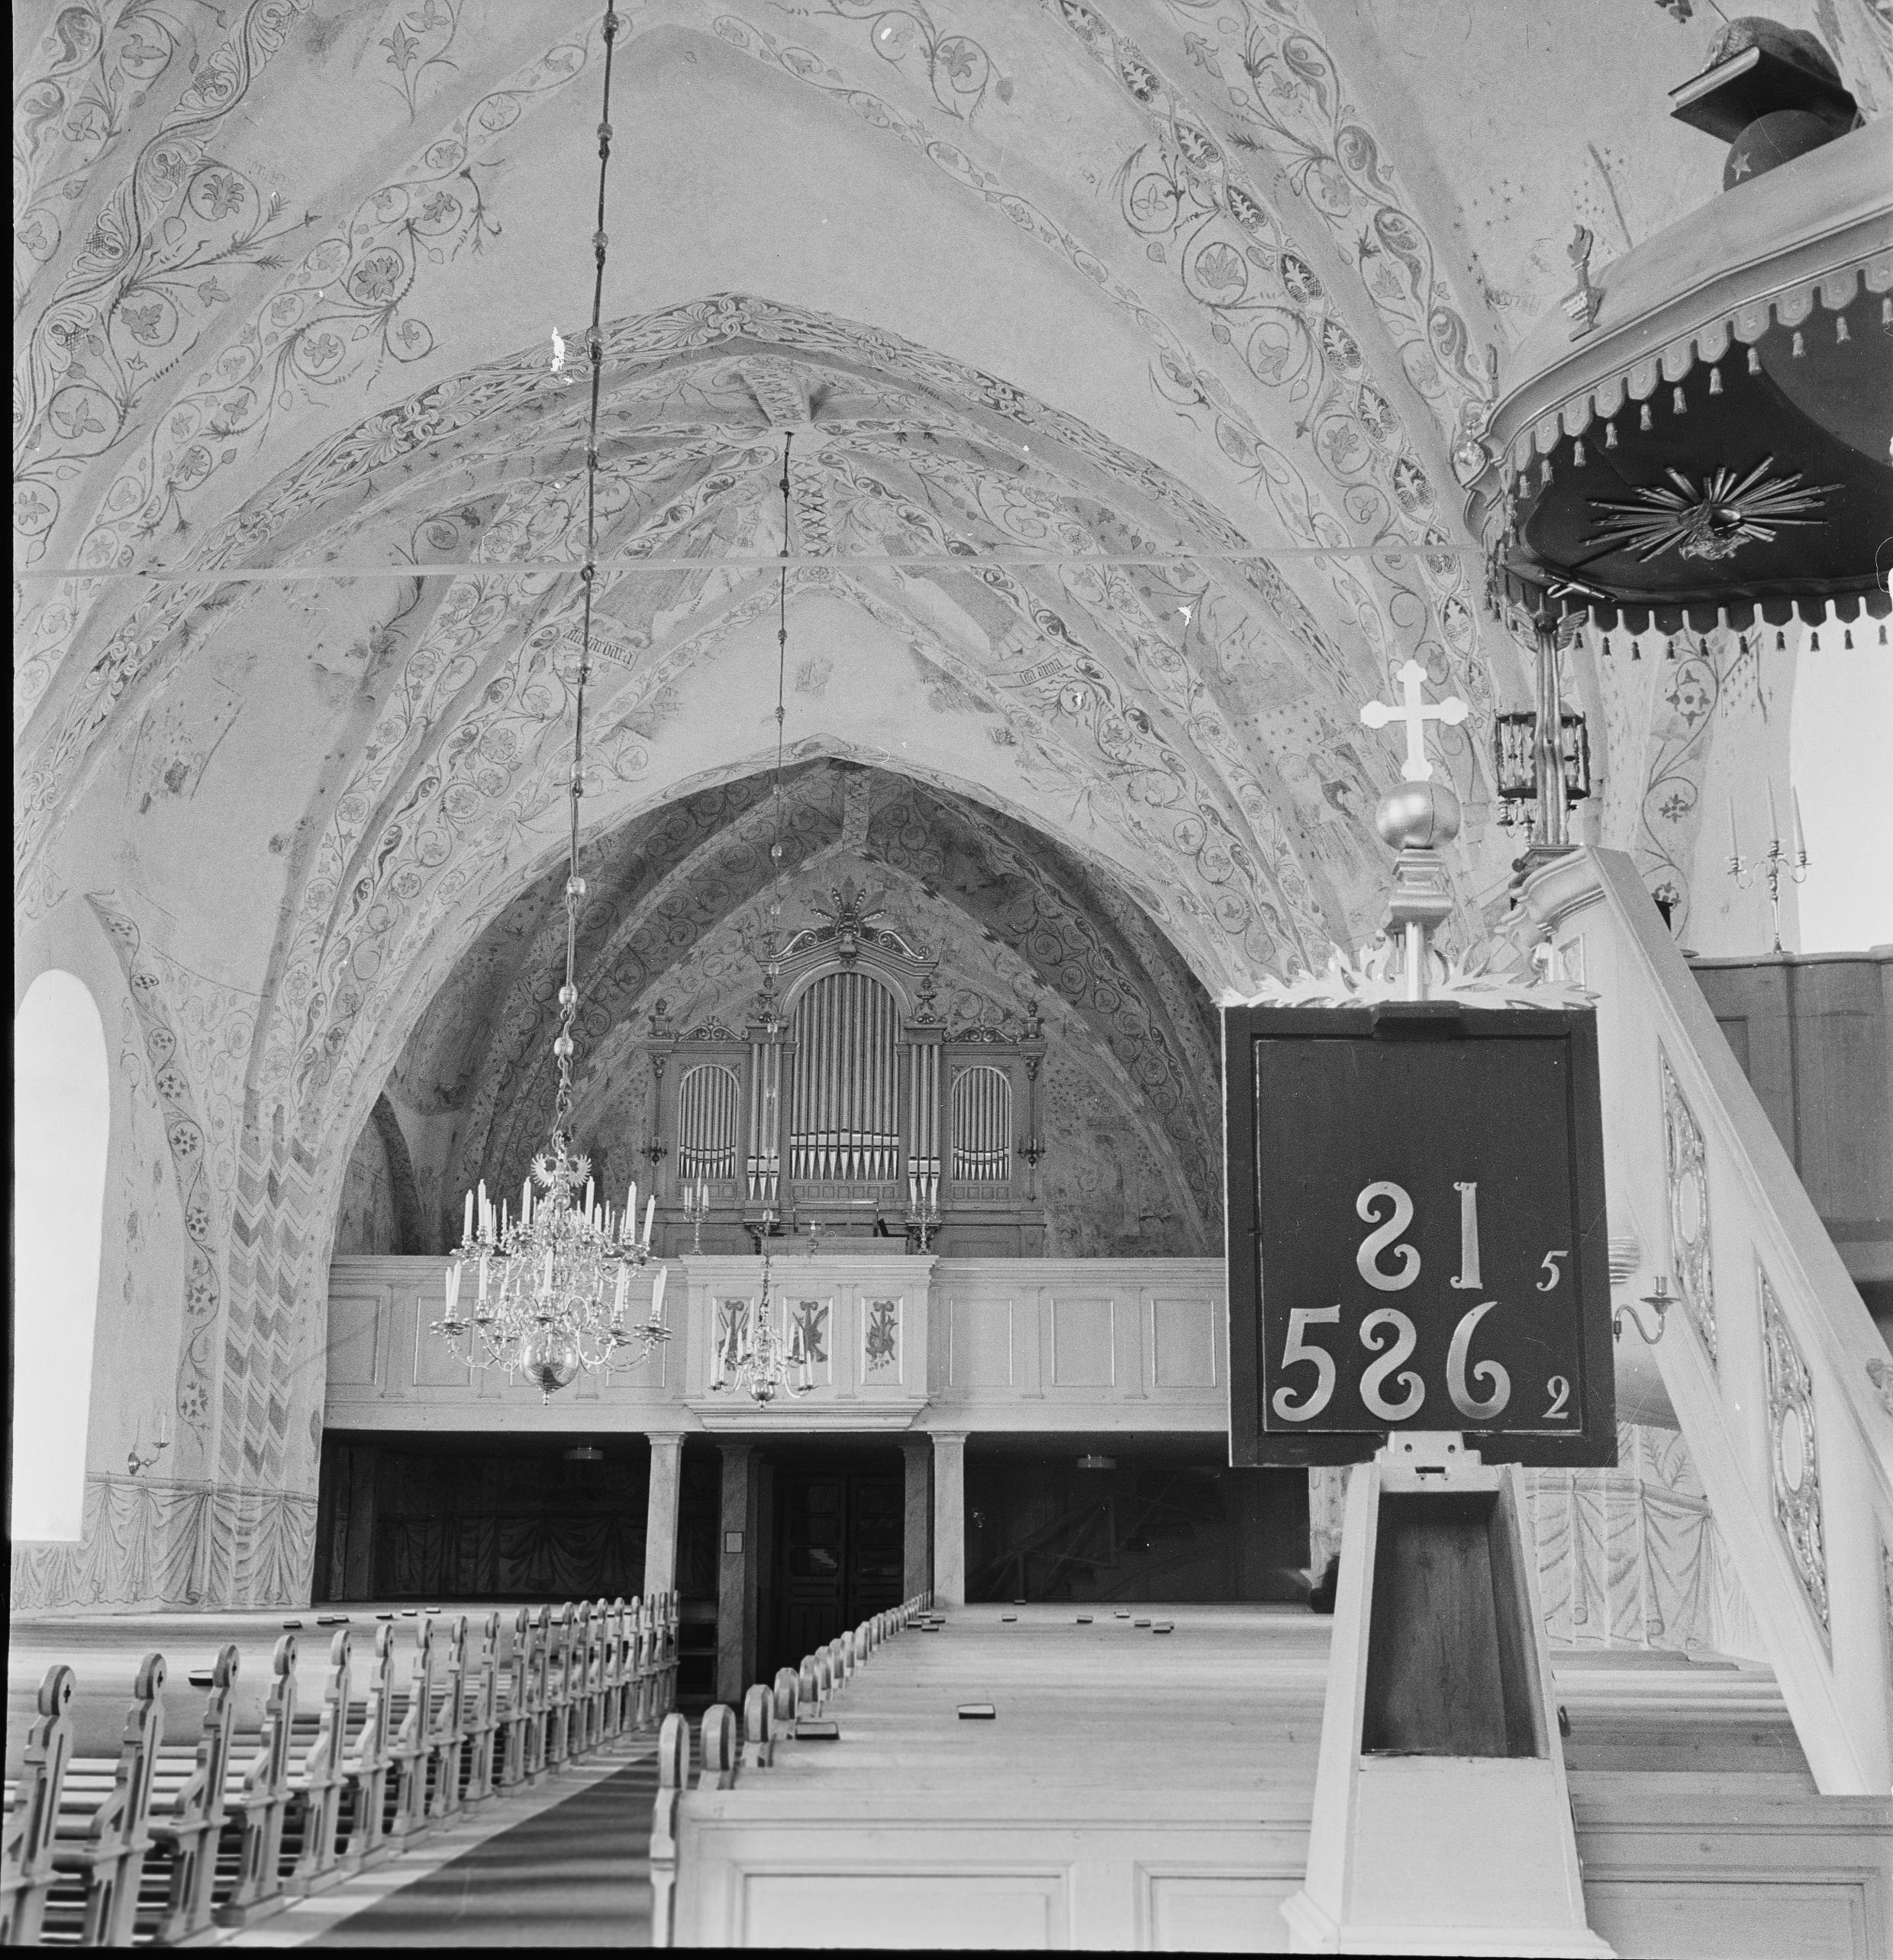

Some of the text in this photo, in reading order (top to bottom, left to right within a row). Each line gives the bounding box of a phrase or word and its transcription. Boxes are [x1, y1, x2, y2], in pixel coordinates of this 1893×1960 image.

[1356, 1181, 1569, 1291] 81 5
[1272, 1301, 1569, 1422] 586 2
